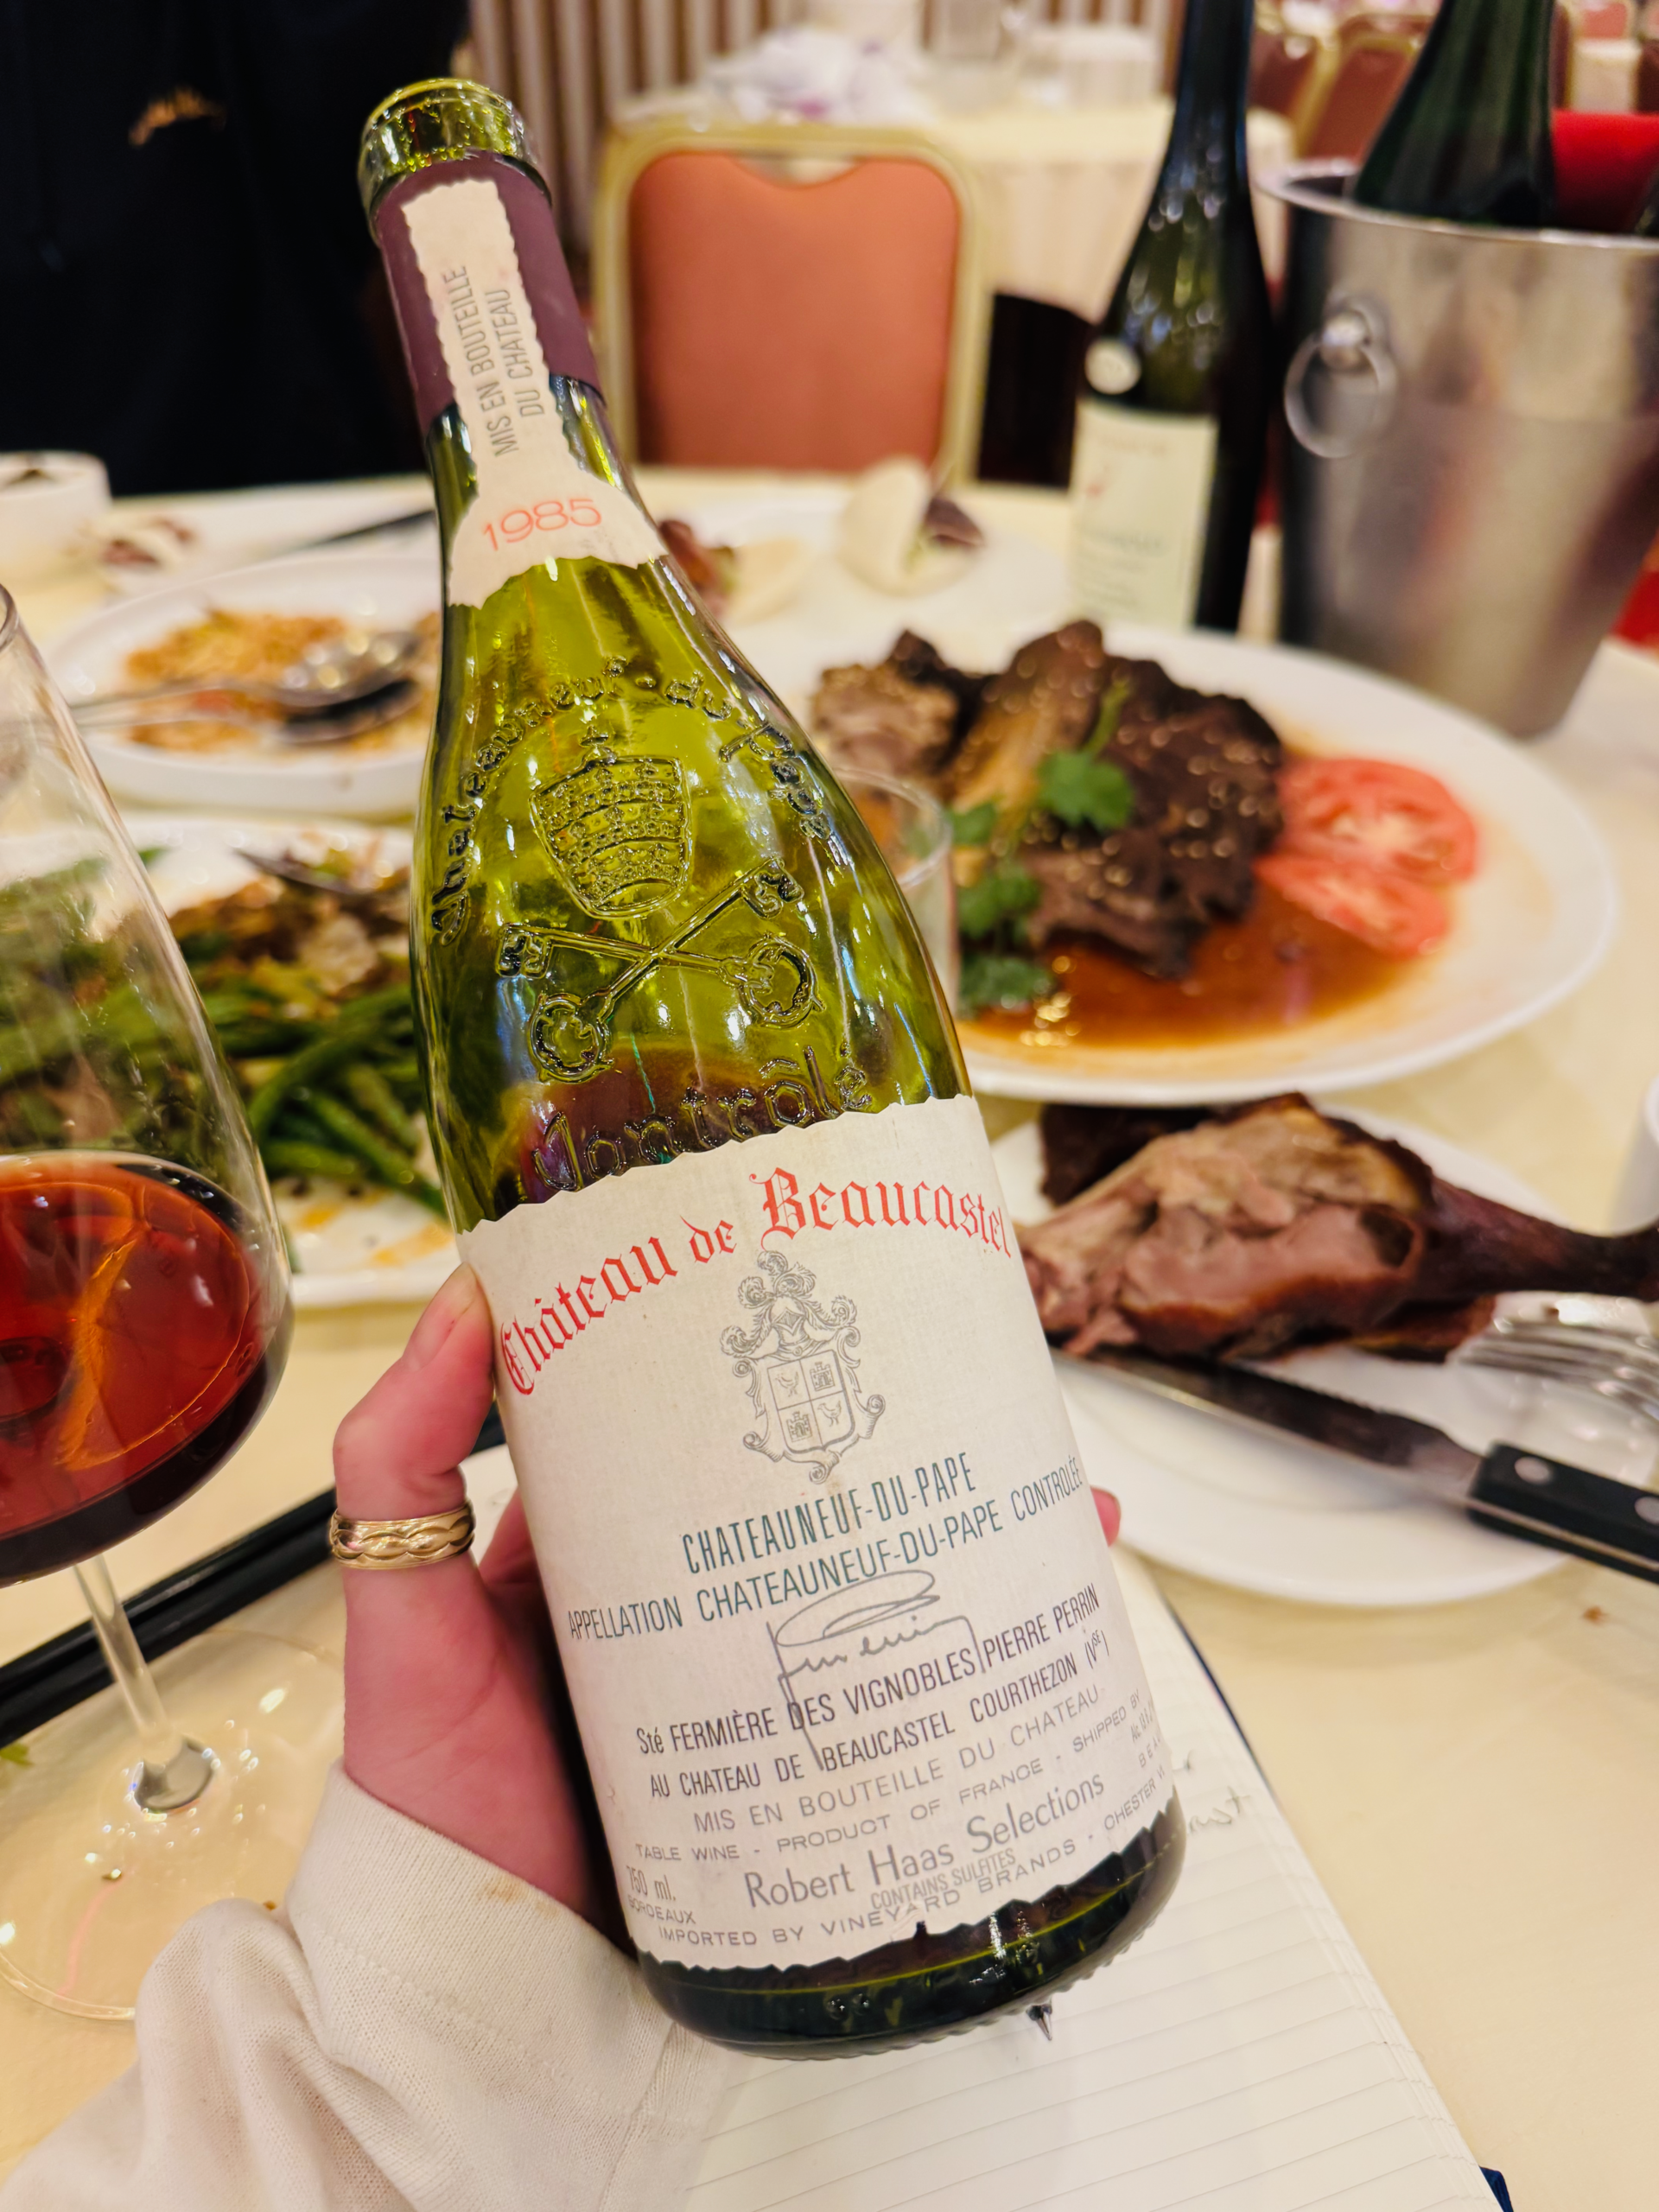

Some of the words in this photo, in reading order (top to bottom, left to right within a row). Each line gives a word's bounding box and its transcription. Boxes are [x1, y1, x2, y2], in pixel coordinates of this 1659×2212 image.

[442, 264, 496, 377] BOUTEILLE
[484, 288, 534, 380] CHATEAU
[476, 380, 506, 413] EN
[486, 414, 519, 458] MIS
[518, 388, 545, 418] DU
[482, 498, 602, 551] 1985
[679, 1214, 738, 1264] de
[748, 1166, 1012, 1259] Beaucastel
[568, 1595, 683, 1641] APPELLATION
[696, 1499, 1003, 1622] CHATEAUNEUF-DU-PAPE
[682, 1452, 976, 1574] CHATEAUNEUF-DU-PAPE
[637, 1726, 664, 1754] Sté
[670, 1707, 779, 1752] FERMIÈRE
[786, 1694, 836, 1731] DES
[842, 1648, 976, 1715] VIGNOBLES
[982, 1613, 1051, 1668] PIERRE
[1052, 1582, 1100, 1634] PERRIN
[651, 1773, 671, 1798] AU
[679, 1762, 761, 1796] CHATEAU
[774, 1754, 805, 1783] DE
[821, 1710, 956, 1772] BEAUCASTEL
[969, 1652, 1078, 1723] COURTHEZON
[635, 1843, 682, 1861] TABLE
[691, 1844, 741, 1861] WINE
[777, 1815, 891, 1853] PRODUCT
[910, 1798, 942, 1821] OF
[958, 1758, 1044, 1805] FRANCE
[1072, 1706, 1127, 1753] SHIPPED
[693, 1809, 736, 1833] MIS
[749, 1802, 784, 1826] EN
[798, 1758, 944, 1817] BOUTEILLE
[958, 1738, 995, 1769] DU
[1010, 1684, 1100, 1747] CHATEAU
[658, 1925, 758, 1946] IMPORTED
[772, 1925, 804, 1944] BY
[821, 1889, 961, 1936] VINEYARD
[977, 1838, 1077, 1894] BRANDS
[1103, 1777, 1156, 1831] CHESTER
[744, 1863, 855, 1909] Robert
[868, 1843, 954, 1886] Haas
[966, 1773, 1104, 1853] Selections
[870, 1873, 950, 1910] CONTAINS
[951, 1847, 1017, 1886] SULFITES
